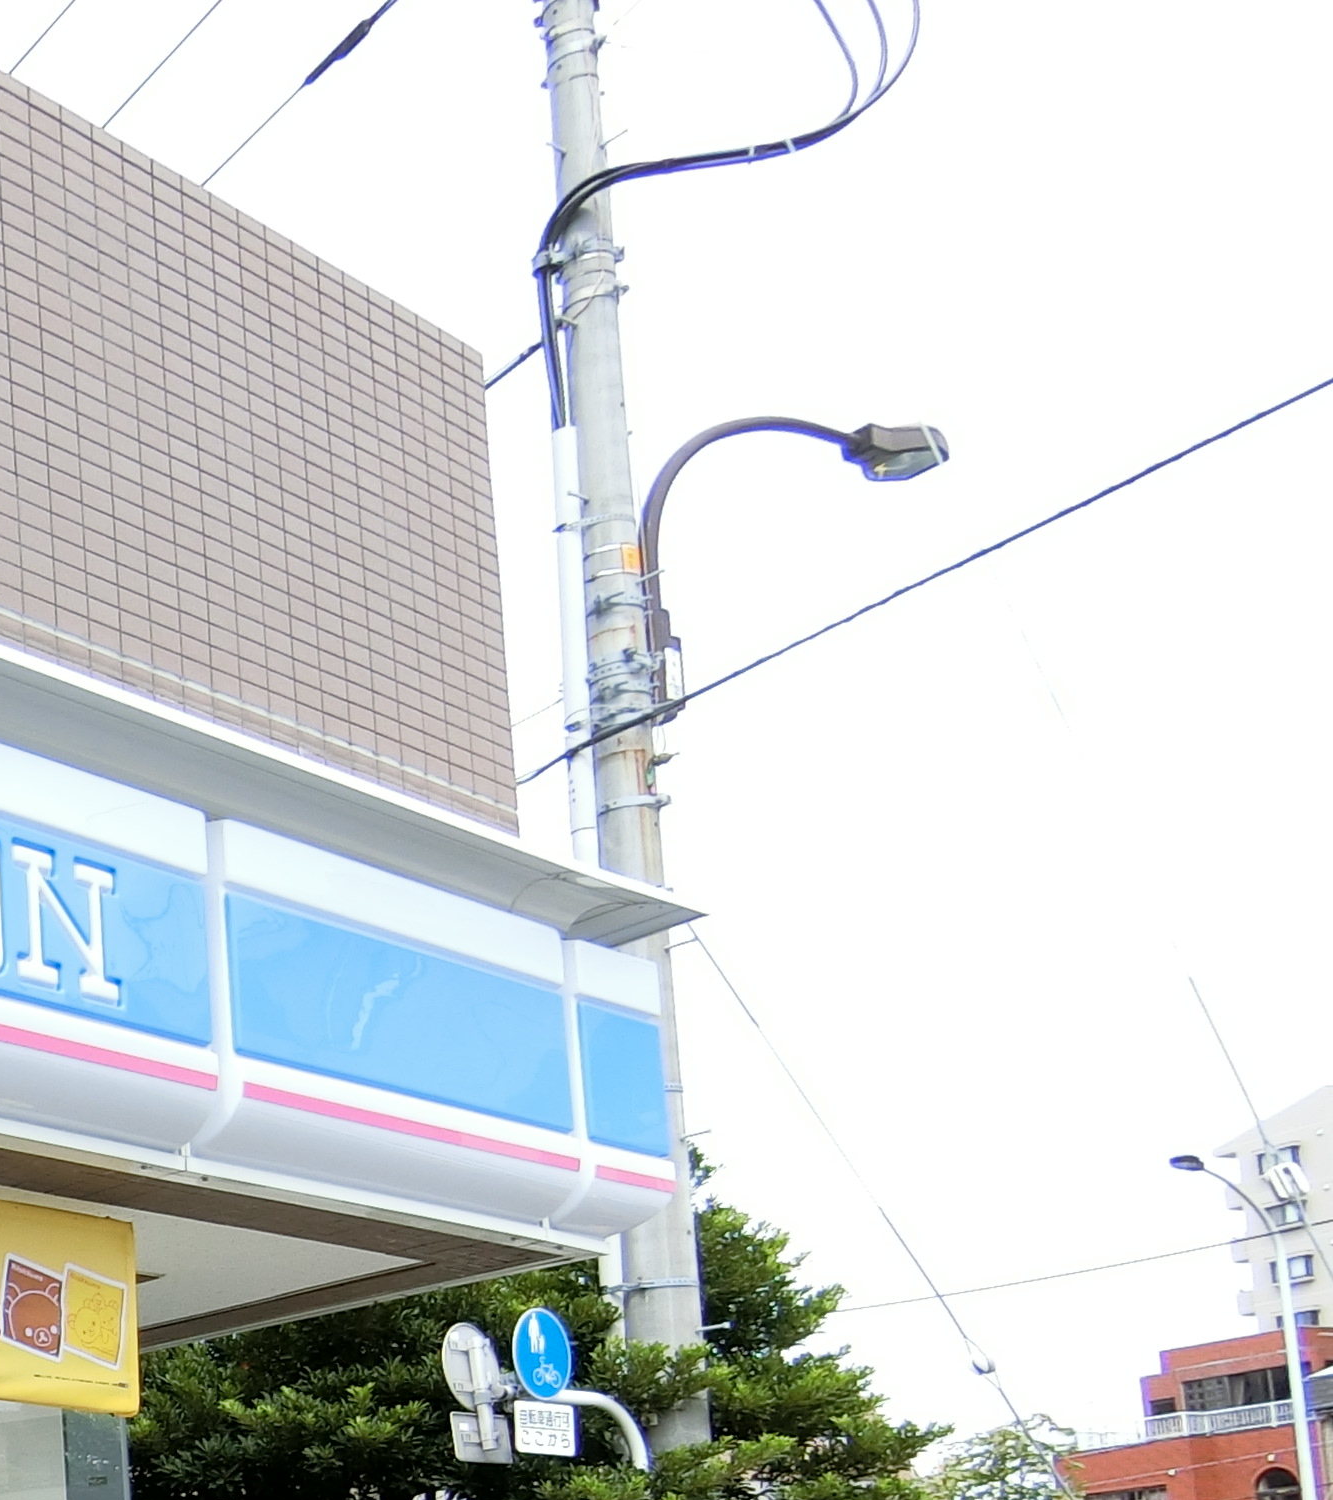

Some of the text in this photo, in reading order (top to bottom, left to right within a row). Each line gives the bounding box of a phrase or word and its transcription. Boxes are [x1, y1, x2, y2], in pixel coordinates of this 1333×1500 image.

[520, 1409, 570, 1428] 自転車通行可
[521, 1429, 571, 1449] ここから
